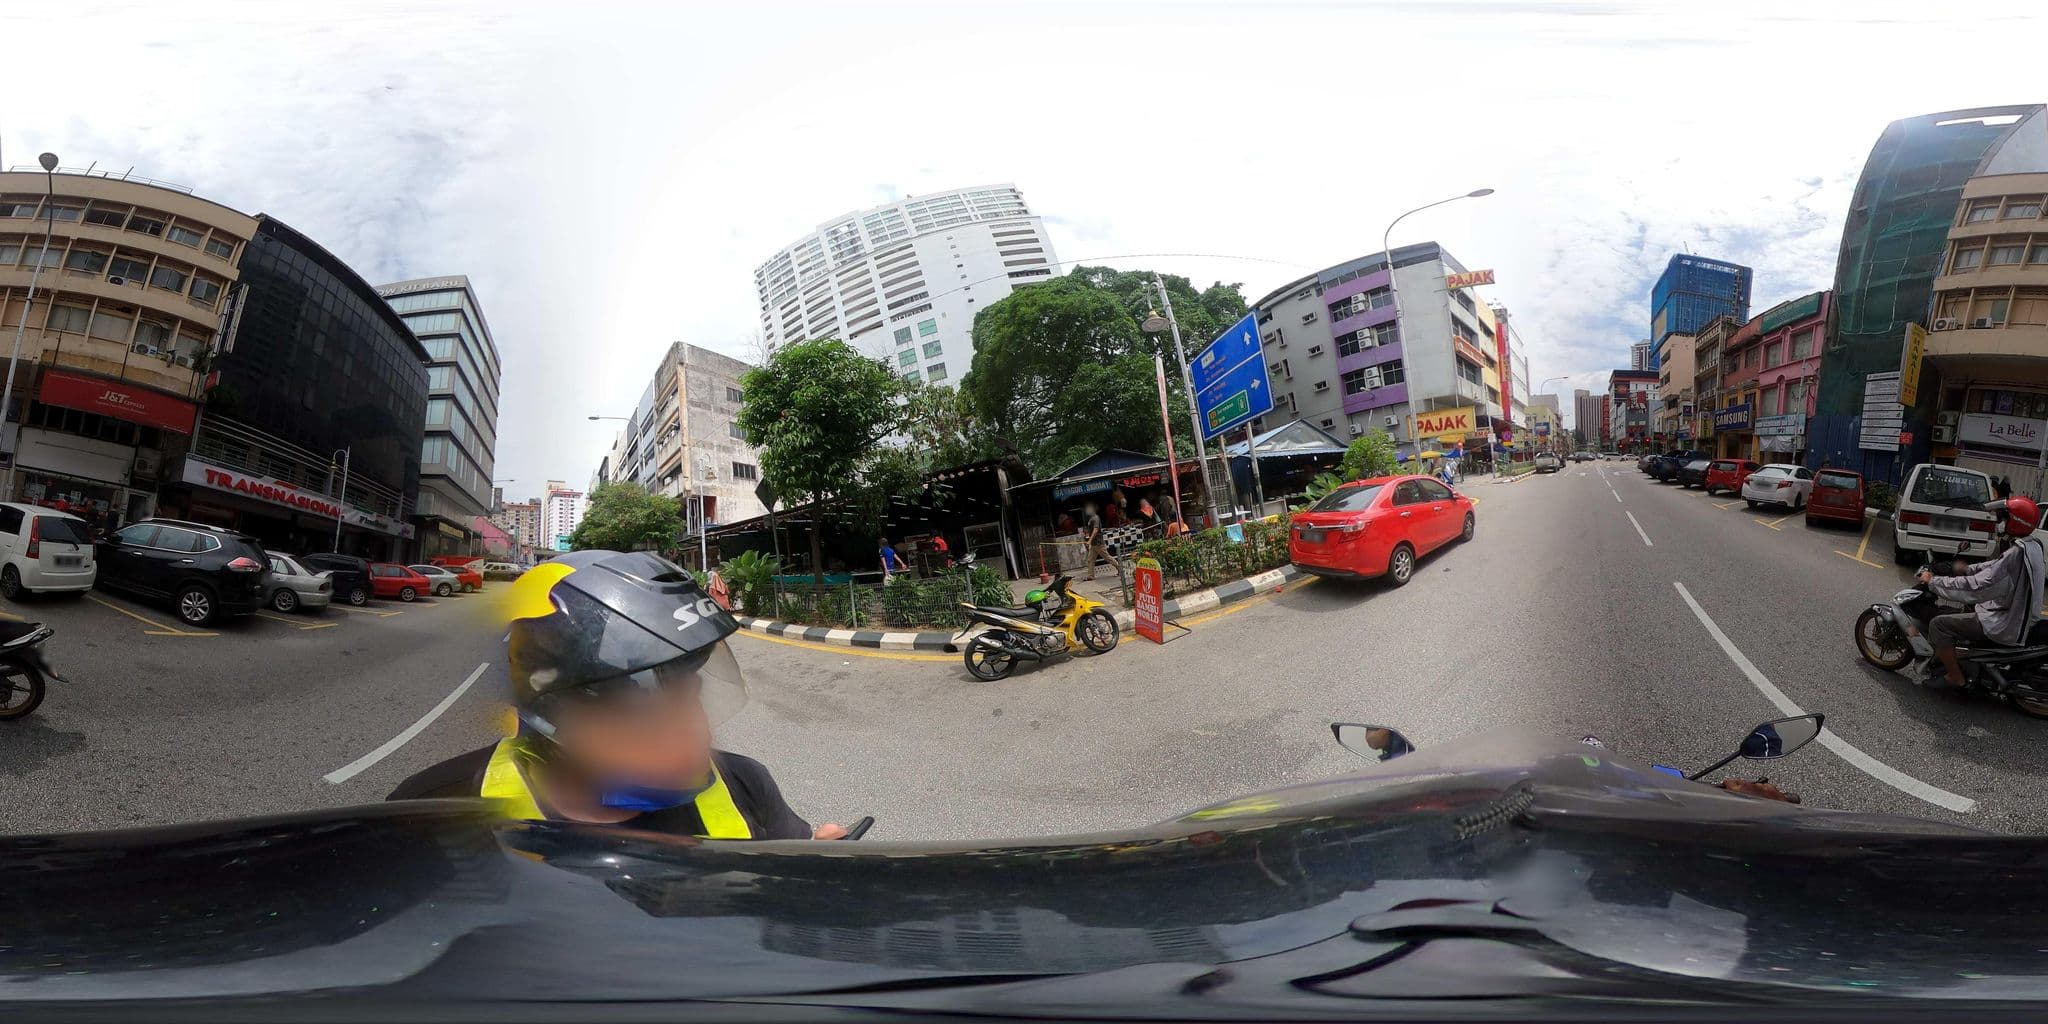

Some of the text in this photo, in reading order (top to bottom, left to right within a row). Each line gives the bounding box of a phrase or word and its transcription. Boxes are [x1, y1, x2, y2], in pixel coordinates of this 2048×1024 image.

[1448, 271, 1493, 288] PAJAK
[378, 288, 397, 296] OW
[400, 284, 420, 294] KIT
[98, 390, 130, 404] J&T
[1416, 414, 1468, 434] PAJAK
[1715, 410, 1749, 426] SAMSUNG
[1989, 422, 2036, 438] La Belle
[205, 468, 345, 520] TRANSNASIONAL
[1138, 592, 1156, 605] PUTU
[1136, 608, 1160, 624] WORLD
